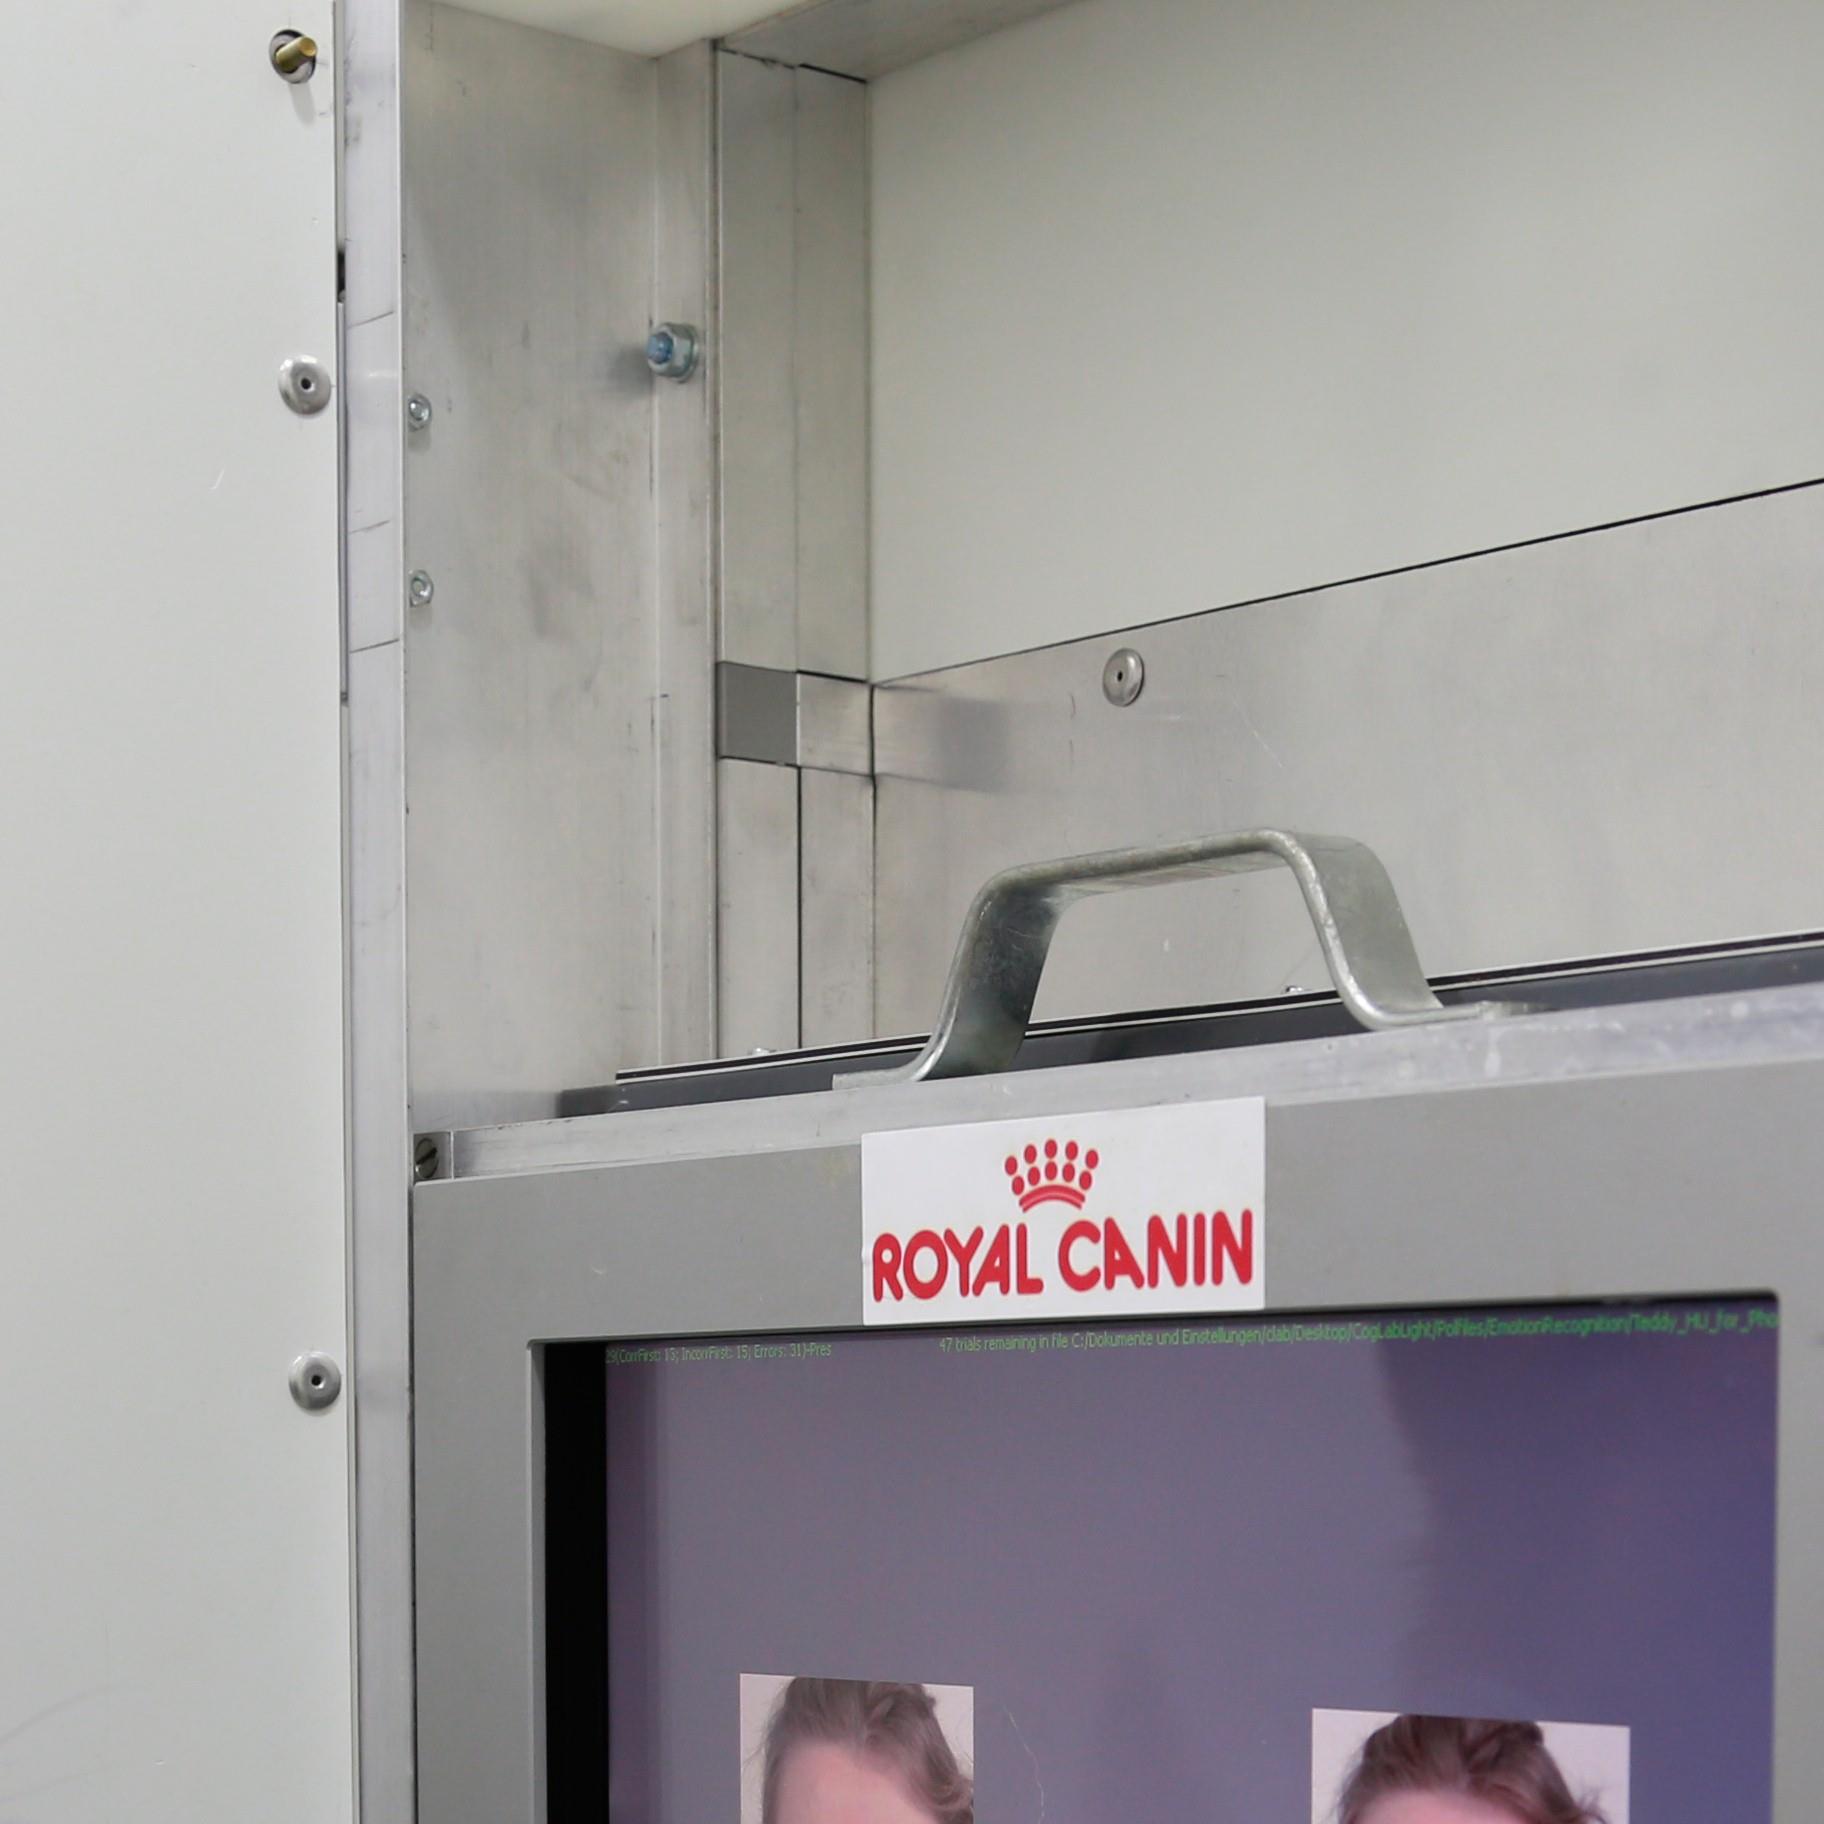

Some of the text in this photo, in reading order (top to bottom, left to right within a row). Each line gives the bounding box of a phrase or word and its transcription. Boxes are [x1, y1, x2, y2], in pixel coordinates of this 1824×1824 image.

[872, 1209, 1252, 1303] ROYAL CANIN
[754, 1343, 786, 1359] Errors:
[939, 1338, 952, 1352] 47
[955, 1336, 981, 1351] trials
[983, 1336, 1036, 1352] remaining
[1039, 1334, 1049, 1348] in
[1051, 1332, 1068, 1348] file
[1071, 1331, 1153, 1349] C:/Dokumente
[1156, 1329, 1179, 1345] und
